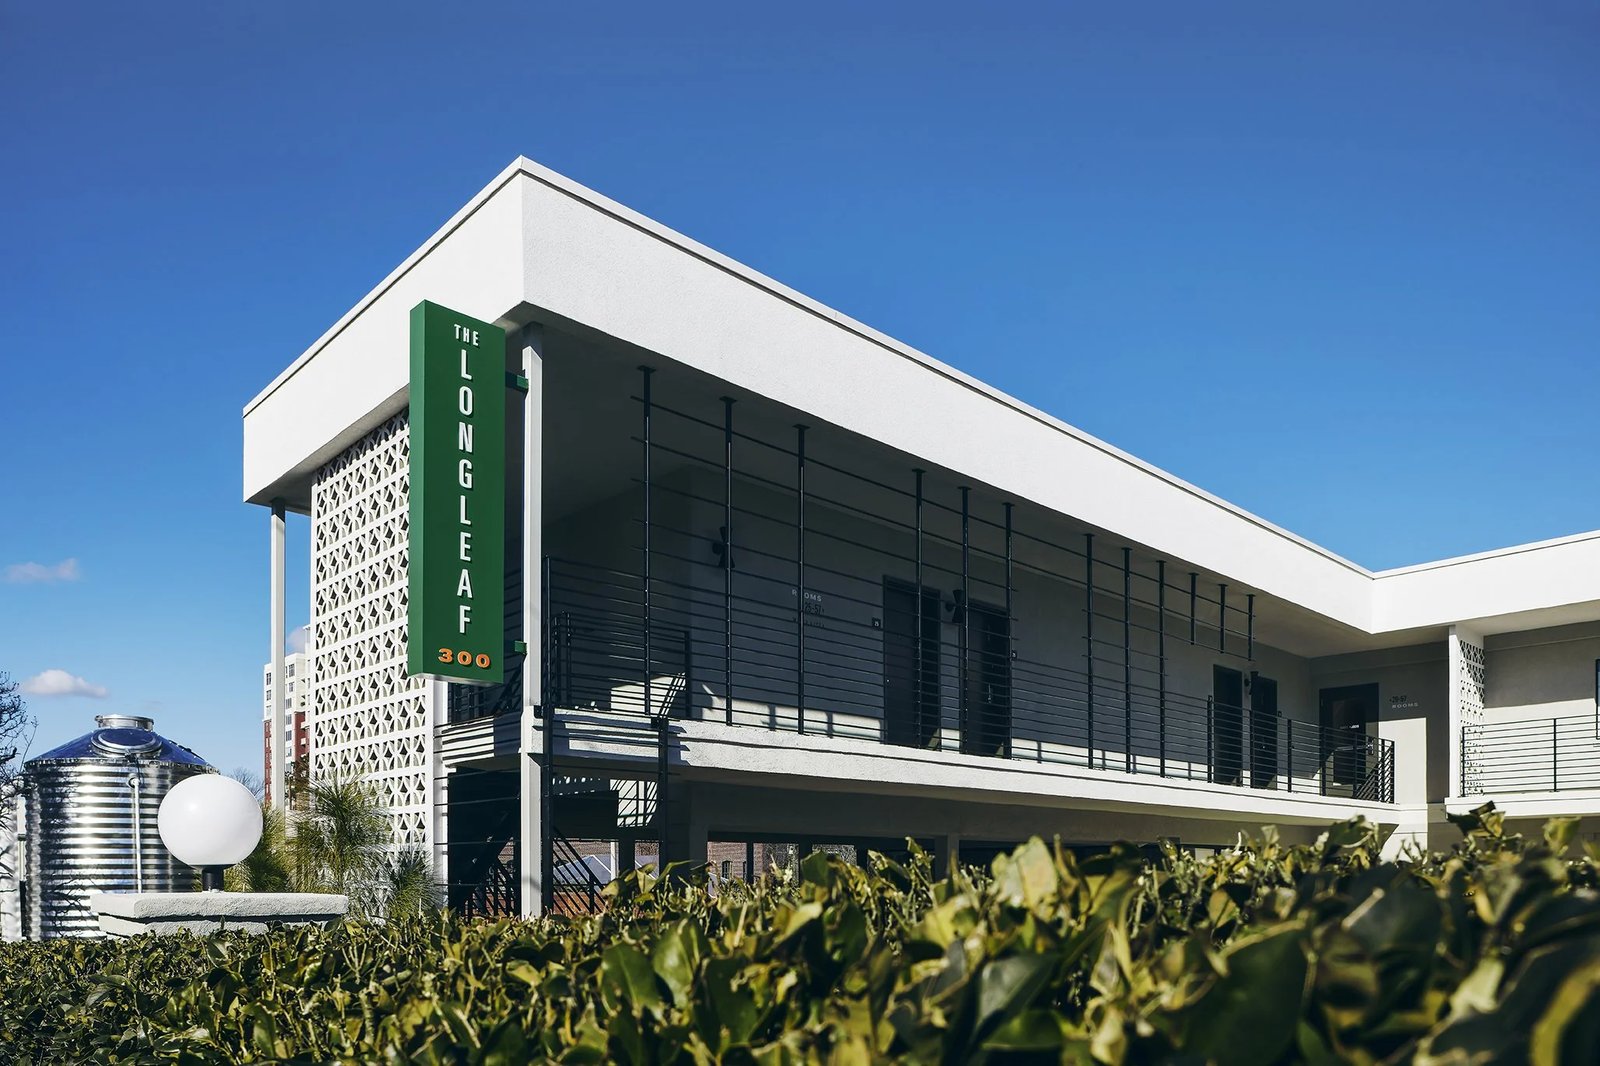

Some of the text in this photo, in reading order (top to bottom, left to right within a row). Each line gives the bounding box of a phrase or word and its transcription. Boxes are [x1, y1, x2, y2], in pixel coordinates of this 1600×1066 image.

[454, 323, 479, 346] THE
[456, 348, 474, 634] LONGLEAF
[791, 589, 822, 602] ROMS
[438, 648, 491, 668] 300
